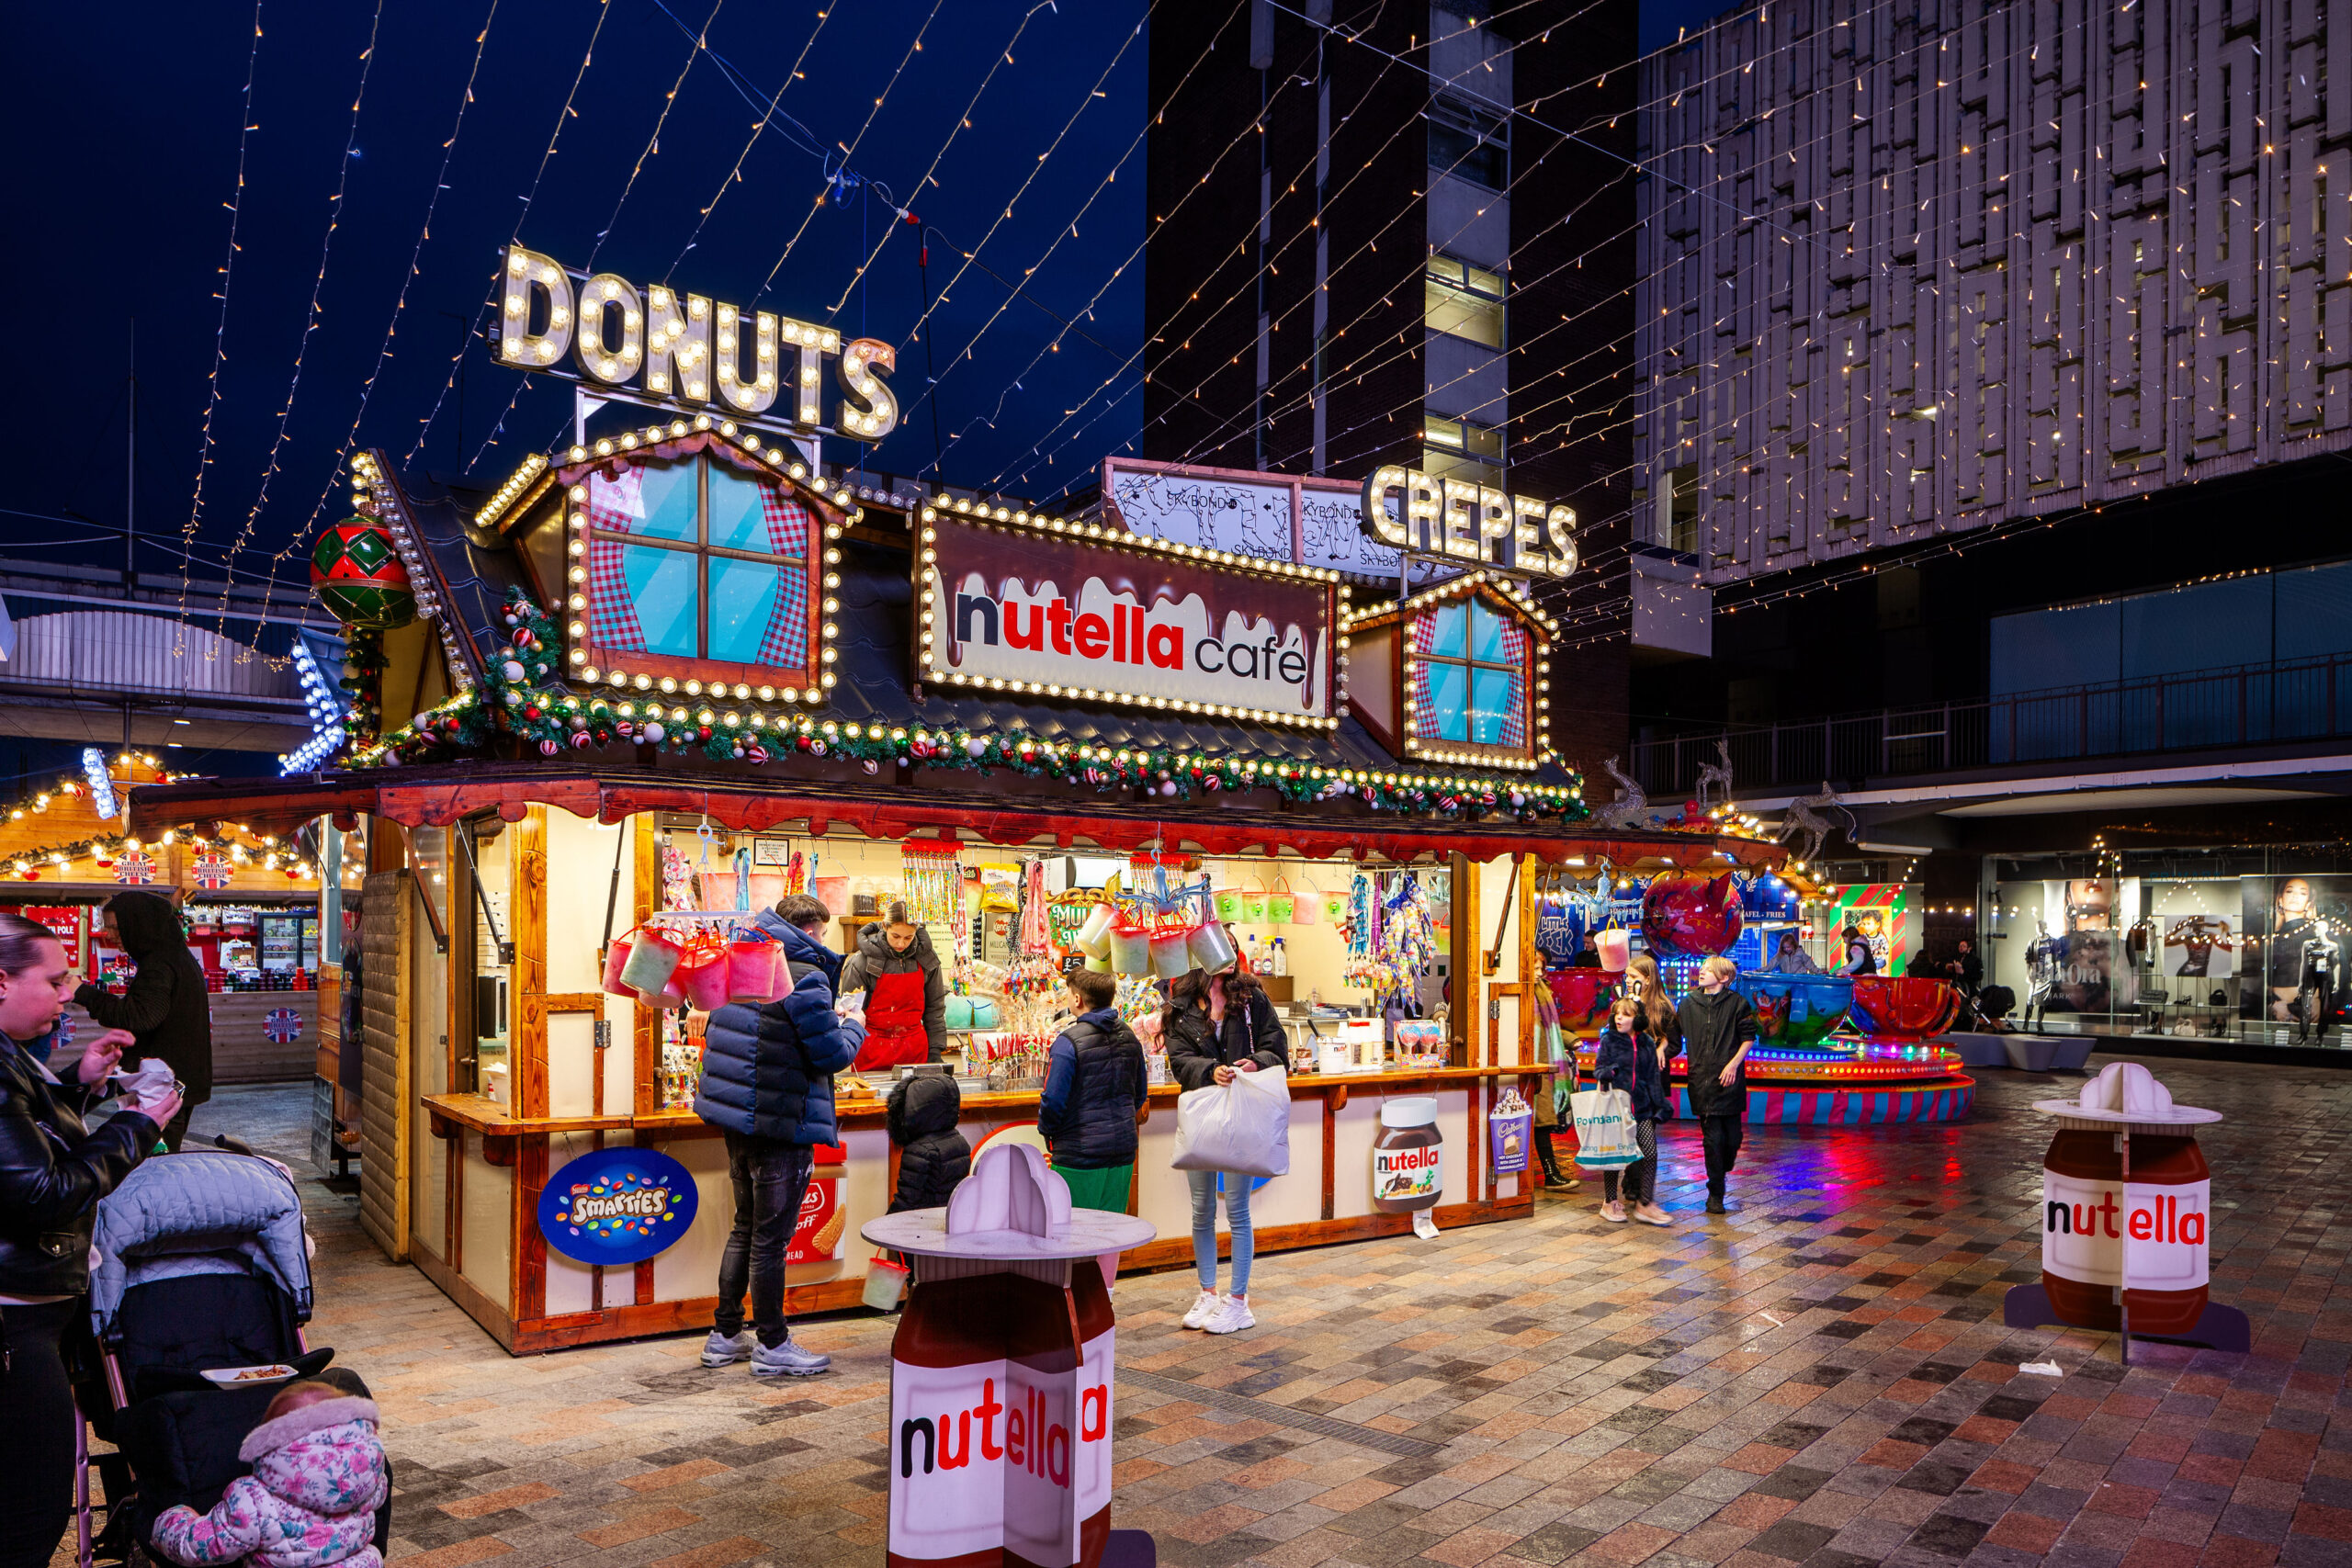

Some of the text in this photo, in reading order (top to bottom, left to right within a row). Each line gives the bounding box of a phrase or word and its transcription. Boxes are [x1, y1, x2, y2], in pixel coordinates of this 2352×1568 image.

[502, 244, 899, 439] DONUTS
[1364, 465, 1577, 577] CREPES
[957, 593, 1306, 684] nutella café
[57, 926, 74, 934] POLE
[1378, 1146, 1439, 1171] nutella
[2048, 1191, 2205, 1245] nutella
[901, 1378, 1069, 1490] nutella
